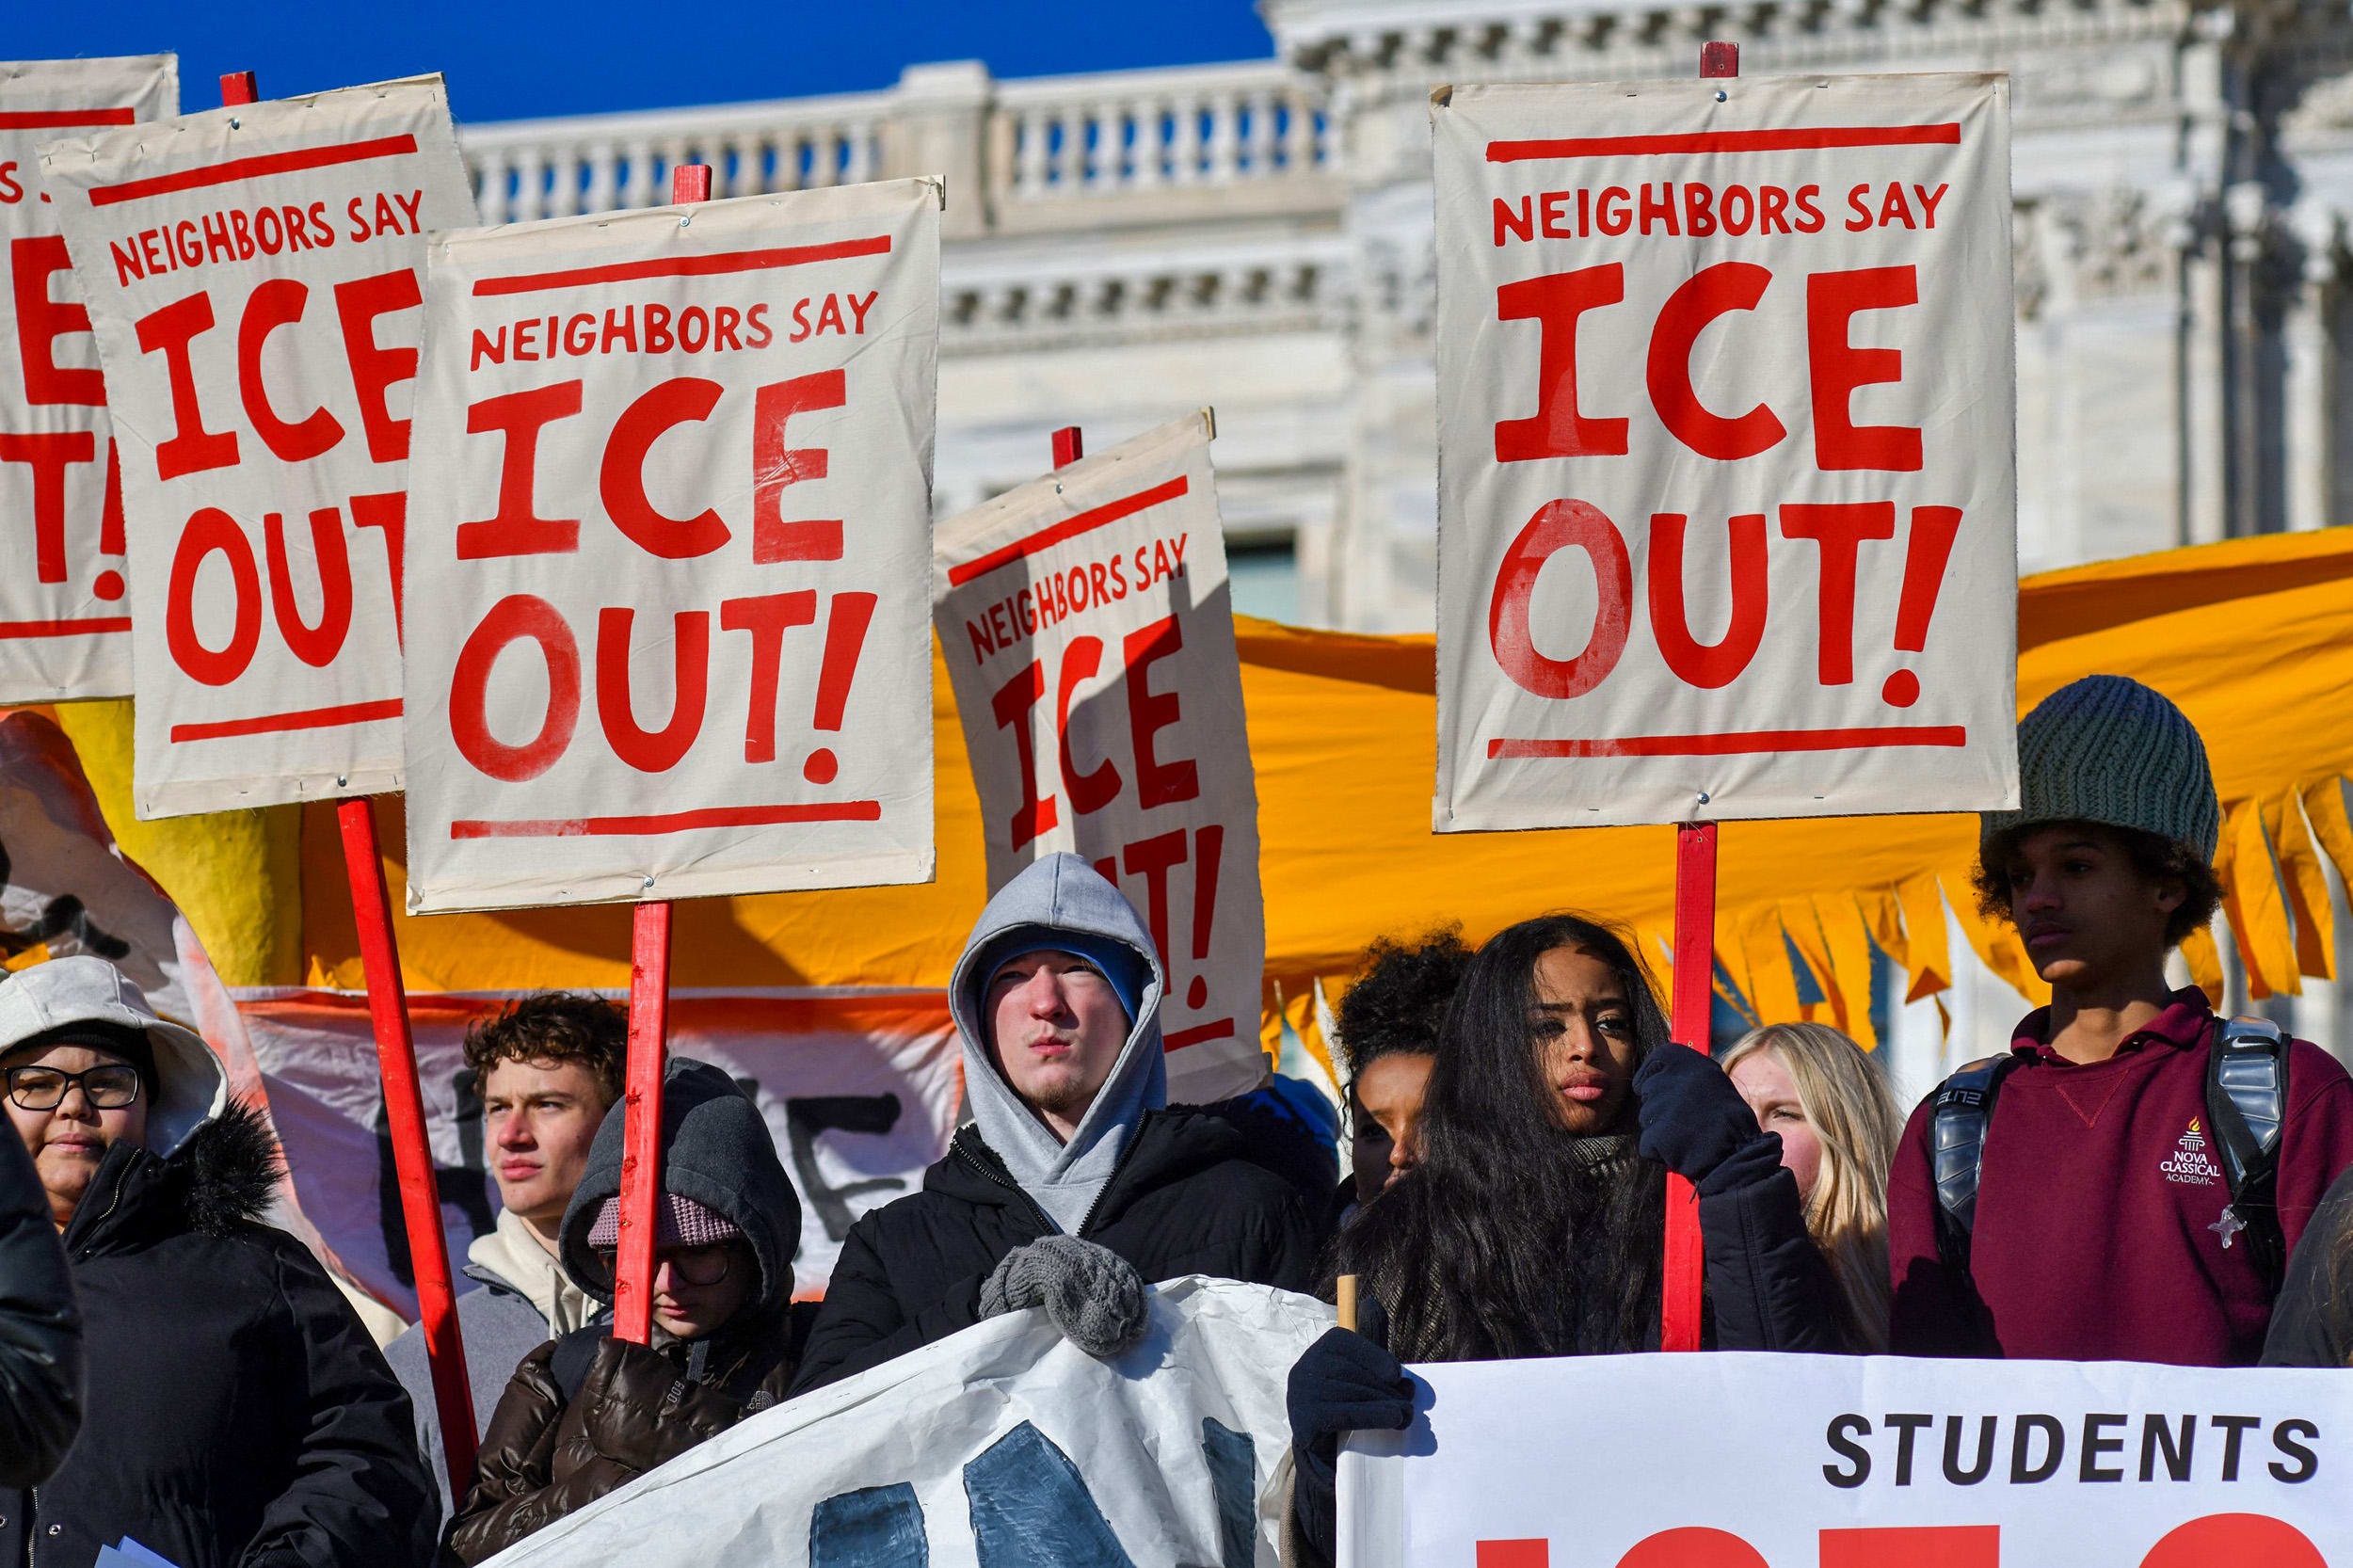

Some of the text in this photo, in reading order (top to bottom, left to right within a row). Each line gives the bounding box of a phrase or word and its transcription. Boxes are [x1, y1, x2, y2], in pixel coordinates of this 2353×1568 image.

[109, 189, 424, 288] NEIGHBORS SAY
[1493, 182, 1950, 247] NEIGHBORS SAY
[134, 267, 424, 482] ICE
[470, 290, 879, 372] NEIGHBORS SAY
[1494, 261, 1924, 472] ICE
[456, 368, 846, 565] ICE
[967, 533, 1189, 665] NEIGHBORS SAY
[1488, 498, 1964, 709] OUT!
[449, 589, 878, 785] OUT!
[991, 613, 1200, 853] ICE
[1937, 1091, 1981, 1106] ELITE
[2160, 1160, 2220, 1177] CLASSICAL
[2166, 1173, 2210, 1186] ACADEMY
[2174, 1150, 2208, 1165] NOVA
[1822, 1413, 2320, 1489] STUDENTS
